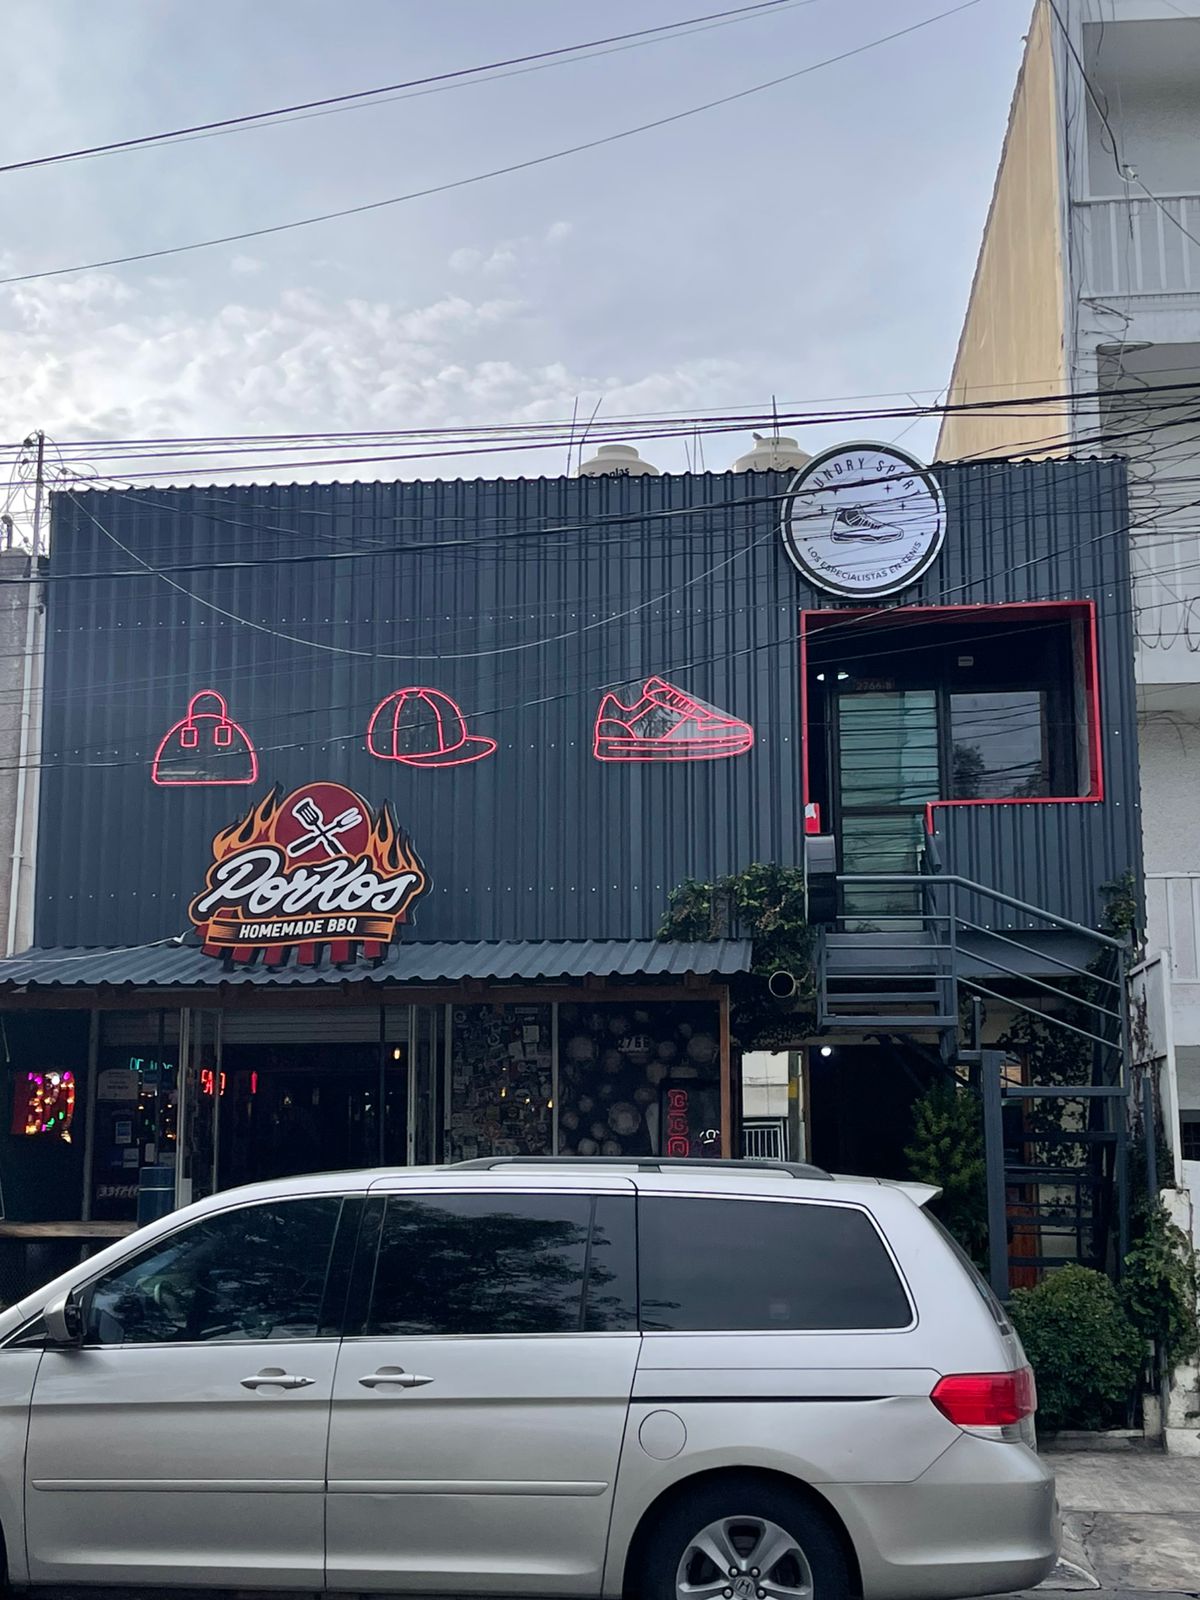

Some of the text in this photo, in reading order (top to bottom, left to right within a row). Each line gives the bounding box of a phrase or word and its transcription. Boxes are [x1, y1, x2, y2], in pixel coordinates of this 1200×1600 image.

[800, 457, 922, 506] LUNDRY SPR
[807, 540, 922, 582] LOS ESPECIALISTAS EN TENIS
[238, 917, 358, 940] HOMEMADE BBQ
